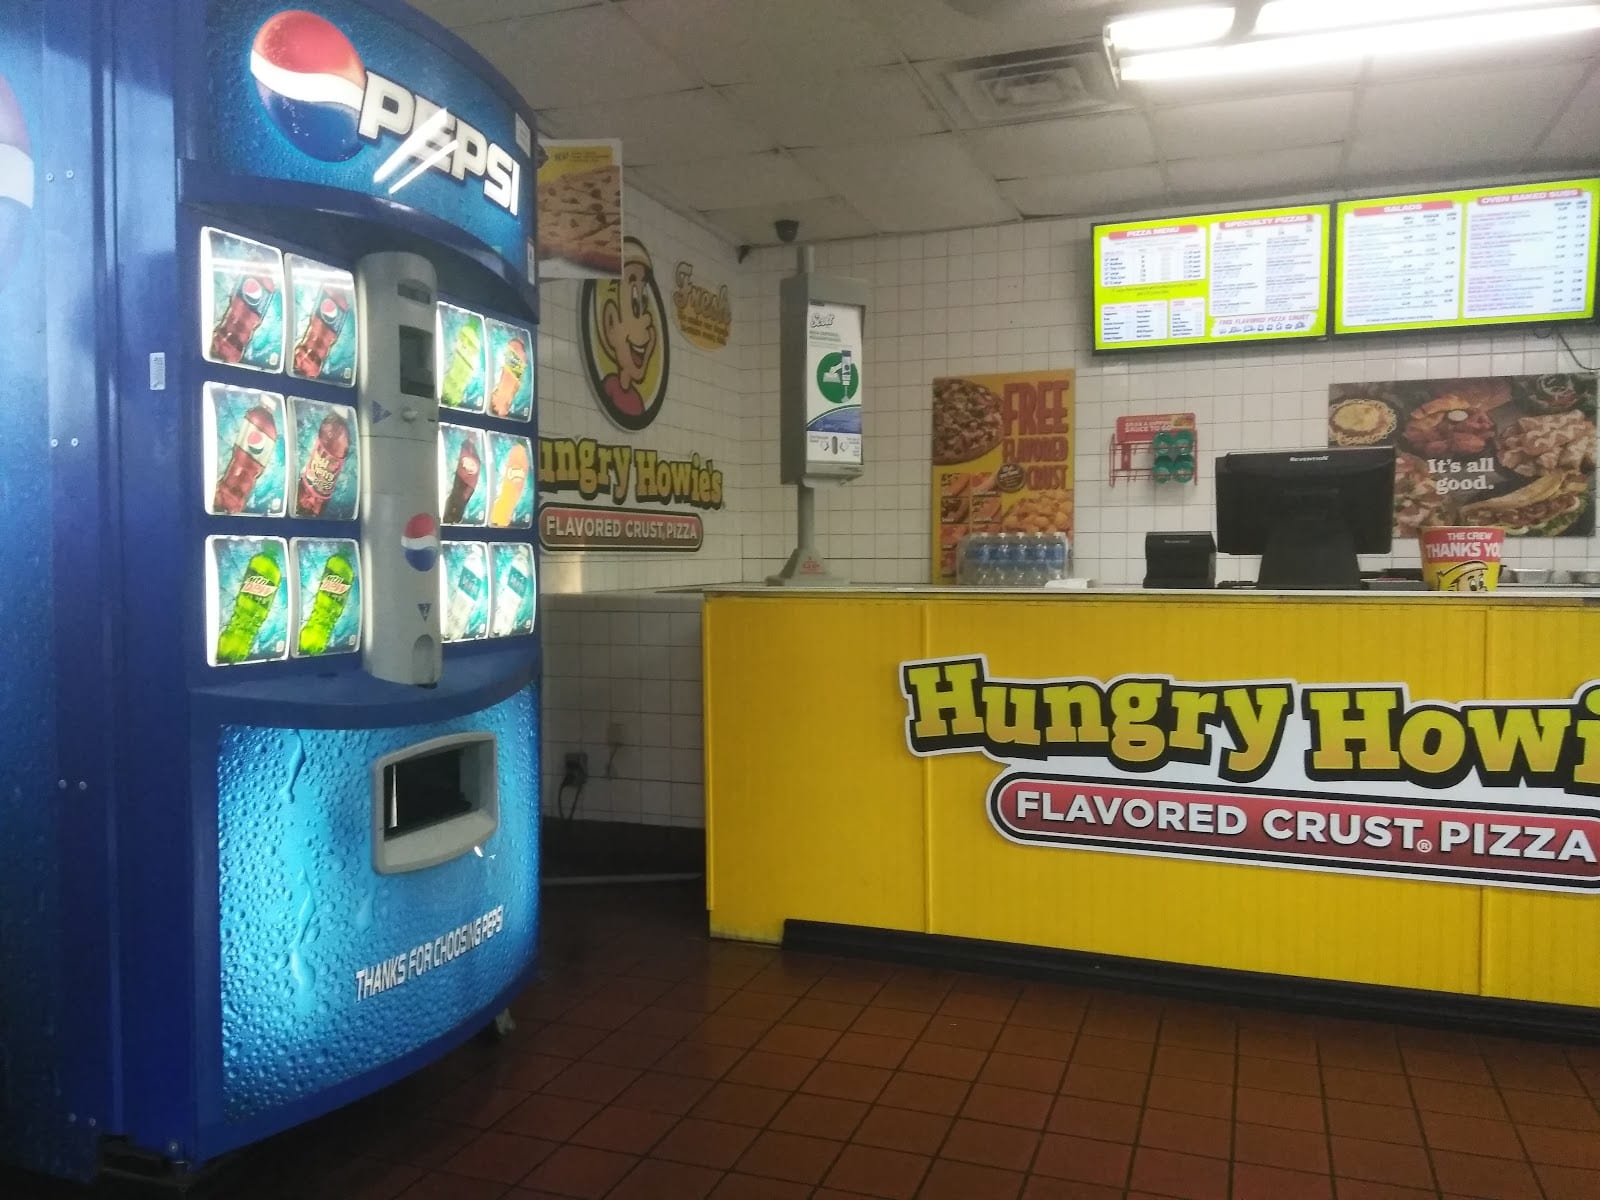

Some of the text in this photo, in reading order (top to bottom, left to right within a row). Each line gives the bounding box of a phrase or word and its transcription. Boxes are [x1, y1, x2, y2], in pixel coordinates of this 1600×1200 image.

[359, 70, 521, 217] PEPSI
[1003, 380, 1069, 435] FREE
[538, 436, 723, 510] ungry Howie's
[1427, 457, 1495, 474] It's all
[1435, 475, 1495, 496] good.
[546, 515, 622, 538] FLAVORED
[666, 522, 698, 540] PIZZA
[1426, 542, 1502, 558] THANKS YO
[1447, 531, 1493, 541] THE CREW
[905, 659, 1292, 780] Hungry
[1016, 790, 1248, 836] FLAVORED
[1440, 820, 1597, 864] PIZZA
[355, 951, 407, 1003] THANKS
[408, 942, 434, 980] FOR
